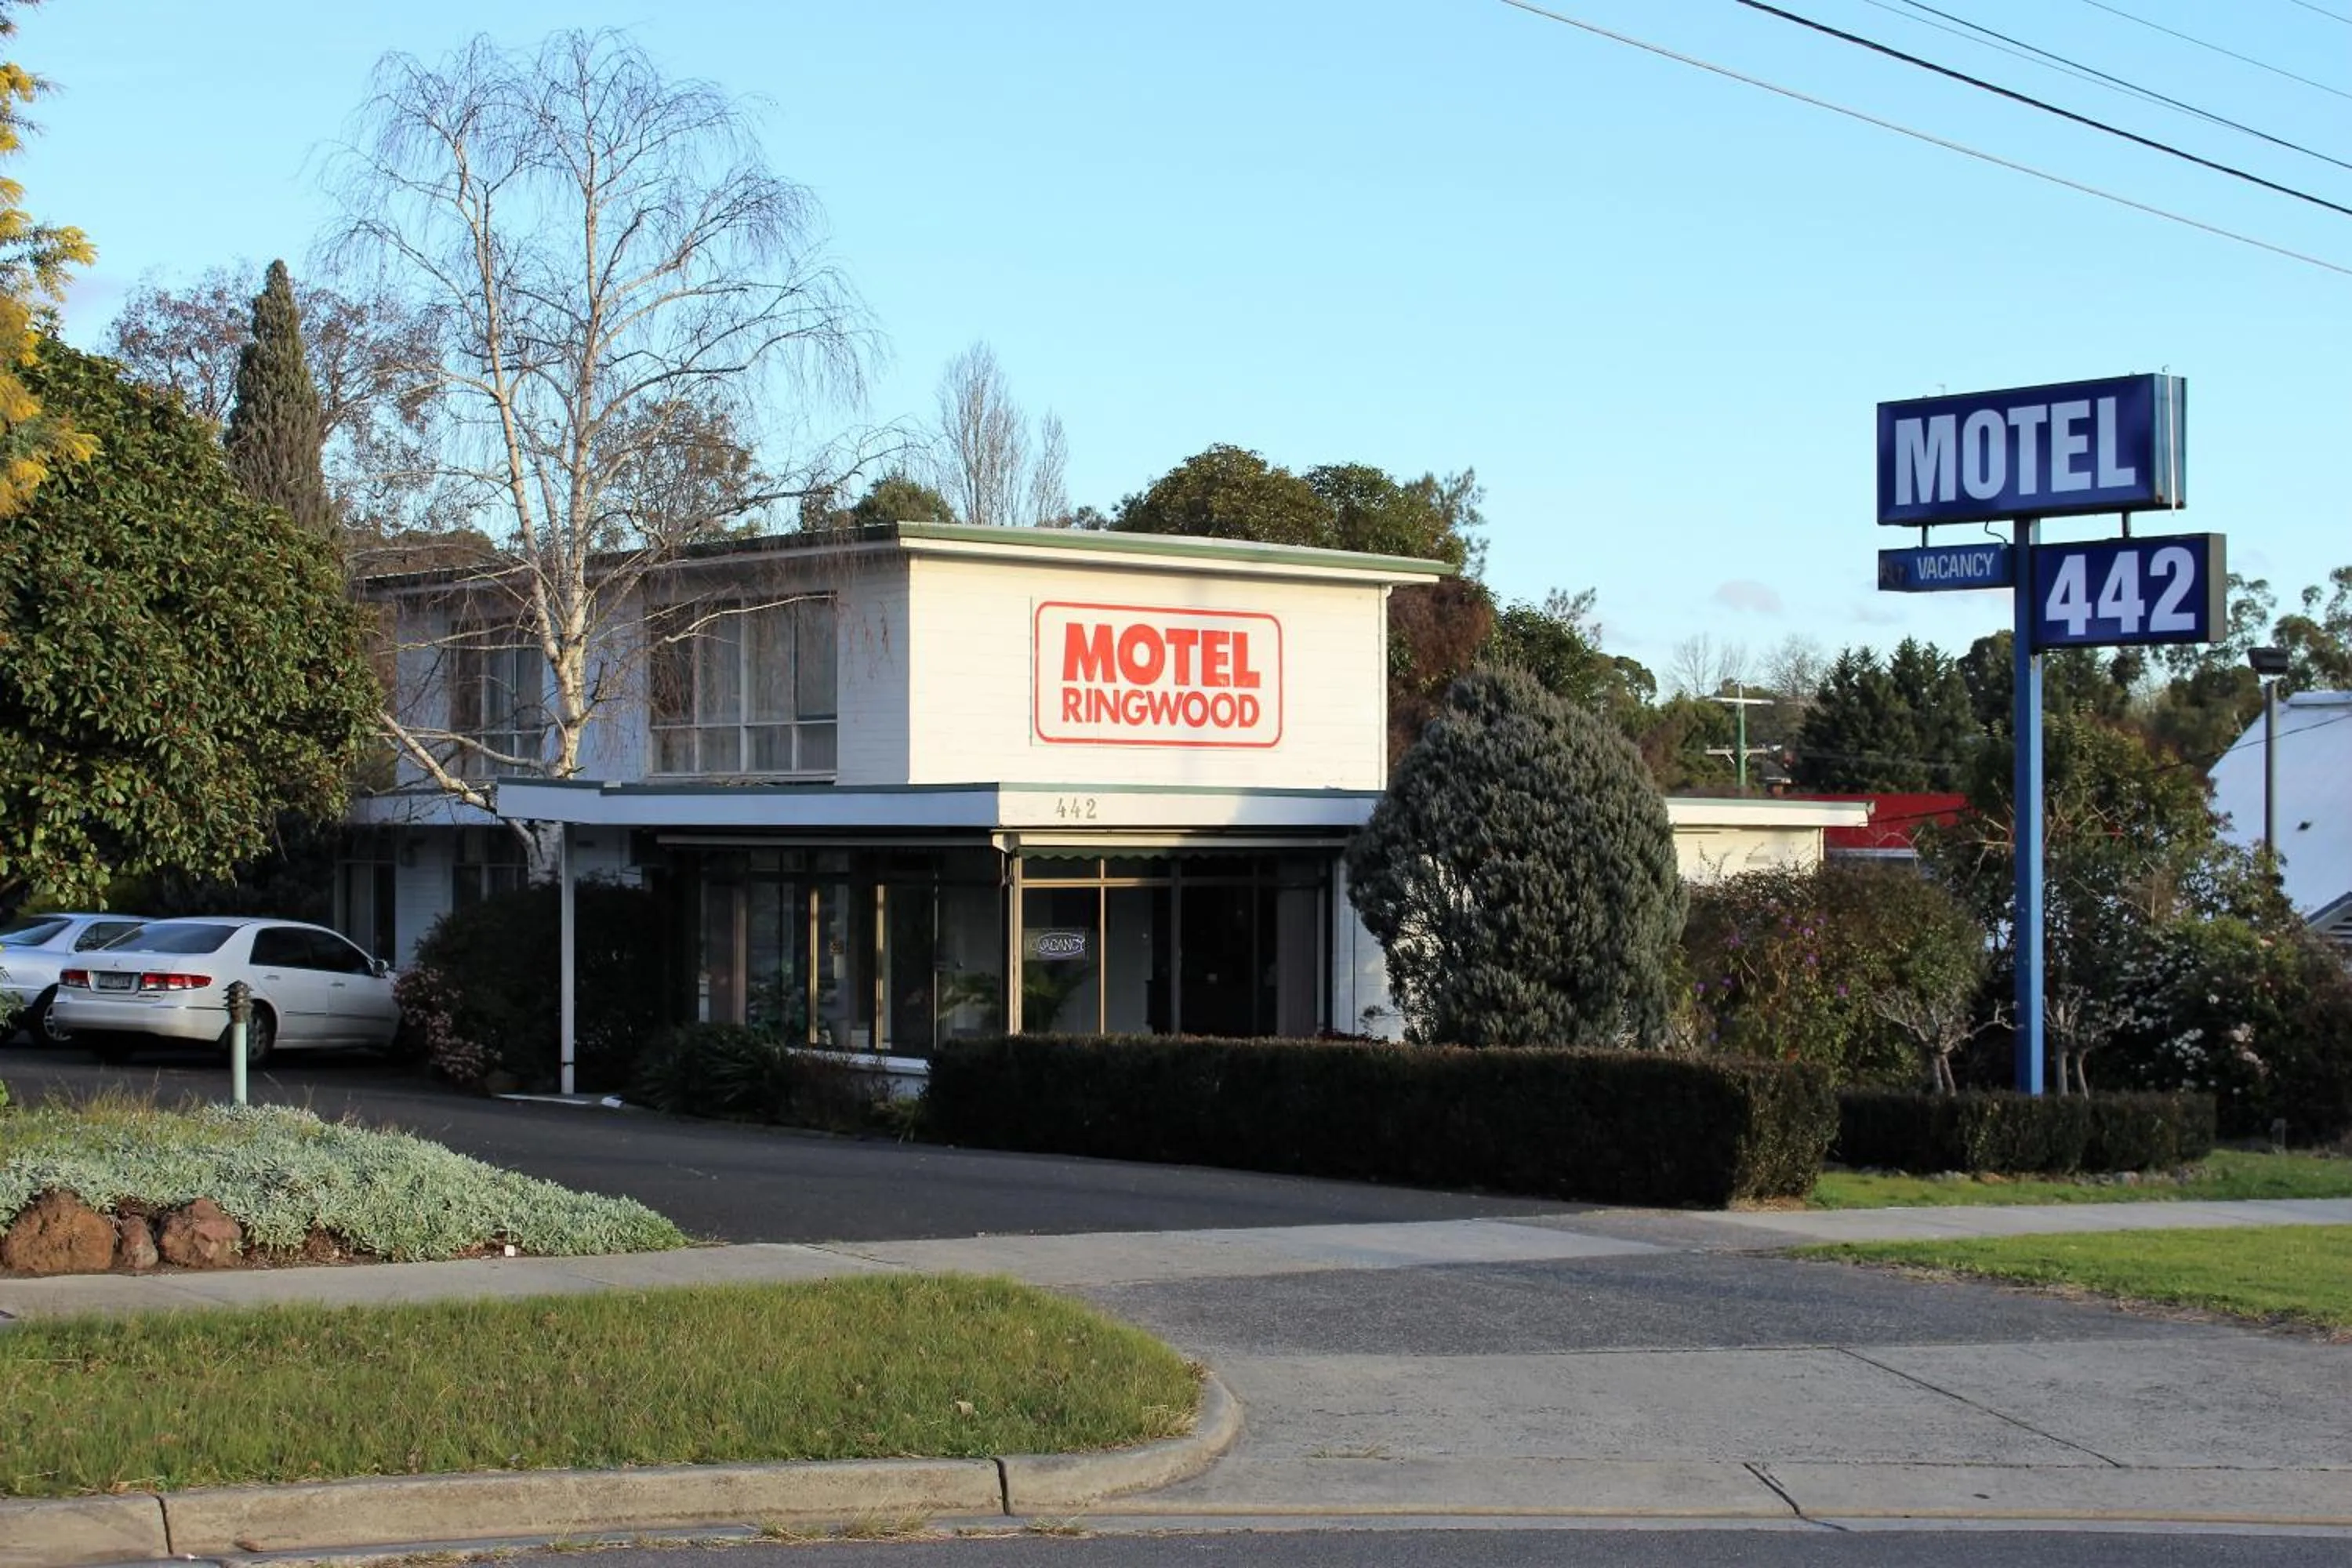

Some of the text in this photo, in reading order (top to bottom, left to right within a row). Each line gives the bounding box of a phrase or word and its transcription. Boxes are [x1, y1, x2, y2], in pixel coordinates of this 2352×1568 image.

[1895, 397, 2136, 506] MOTEL
[1916, 552, 1994, 580] VACANCY
[2045, 546, 2195, 637] 442
[1062, 622, 1260, 688] MOTEL
[1062, 687, 1260, 728] RINGWOOD
[1056, 797, 1097, 819] 442
